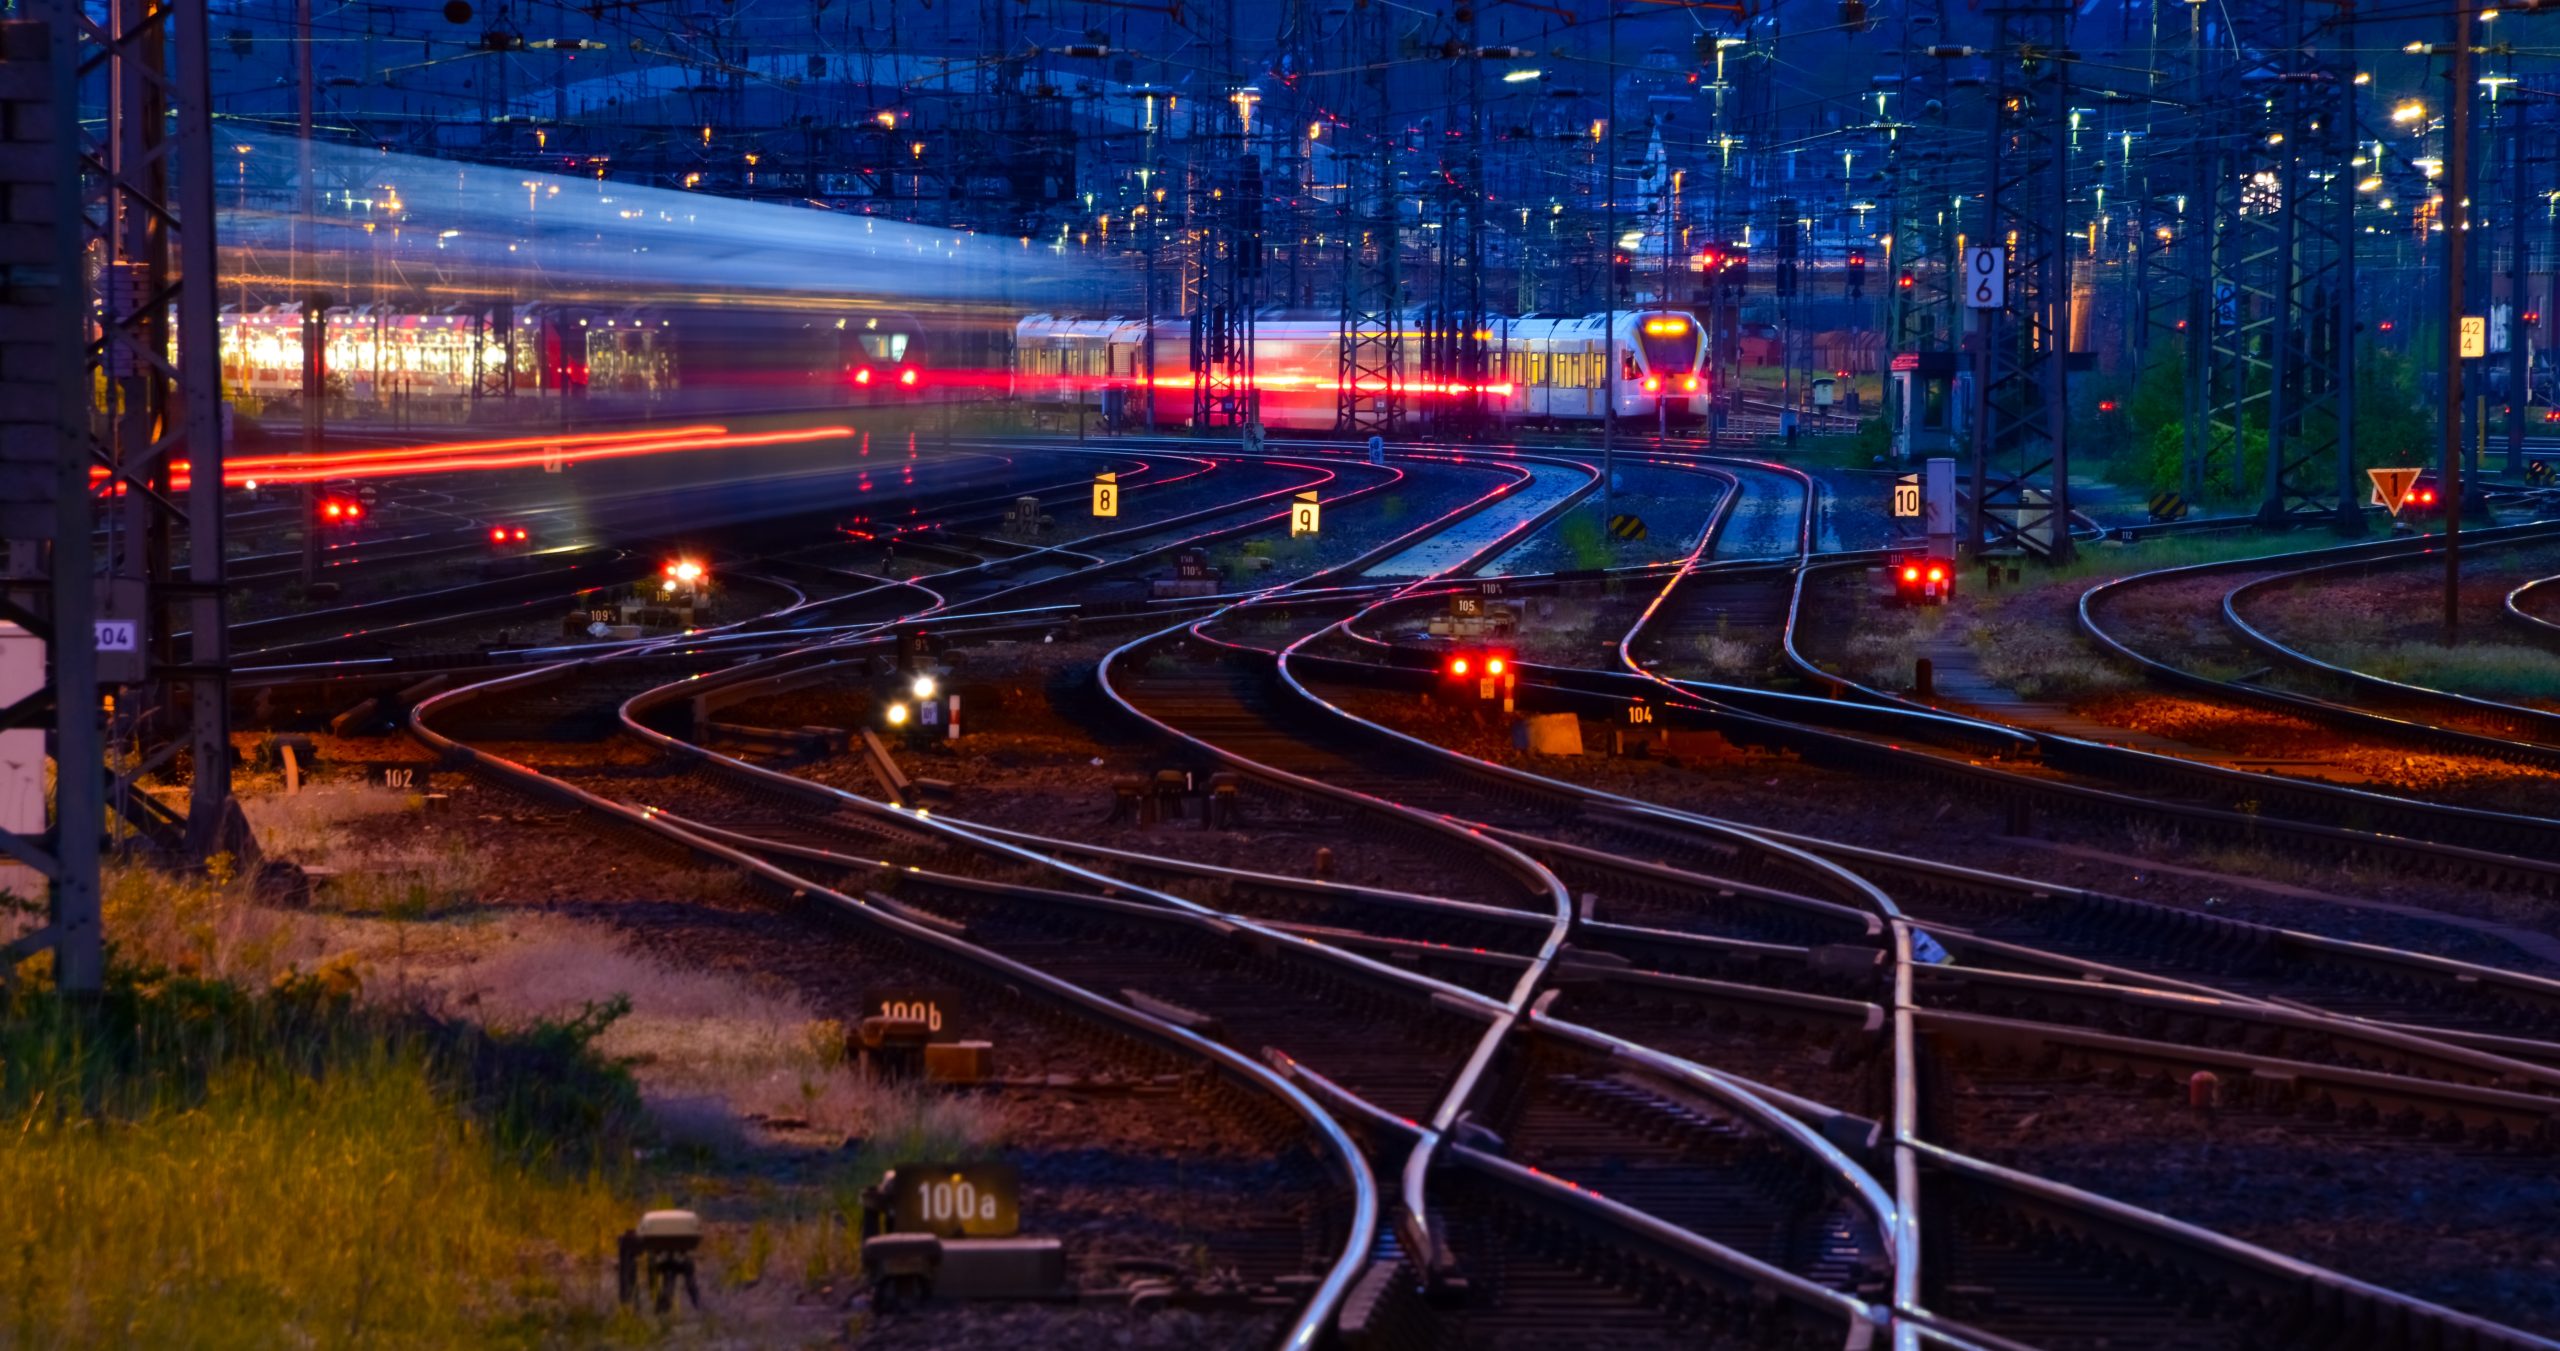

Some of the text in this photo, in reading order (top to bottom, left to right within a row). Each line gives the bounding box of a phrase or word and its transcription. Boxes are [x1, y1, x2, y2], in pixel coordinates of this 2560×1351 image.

[1976, 251, 1994, 275] 0
[1976, 278, 1993, 302] 6
[2461, 321, 2480, 335] 42
[2463, 337, 2472, 351] 4
[2390, 472, 2398, 498] 1
[1100, 489, 1110, 511] 8
[1896, 490, 1917, 513] 10
[1300, 509, 1311, 531] 9
[2122, 531, 2133, 540] 112
[655, 590, 671, 602] 115
[1458, 599, 1475, 613] 105
[1628, 706, 1653, 724] 104
[384, 767, 414, 788] 102
[880, 1000, 943, 1032] 100b
[918, 1181, 996, 1222] 100a
